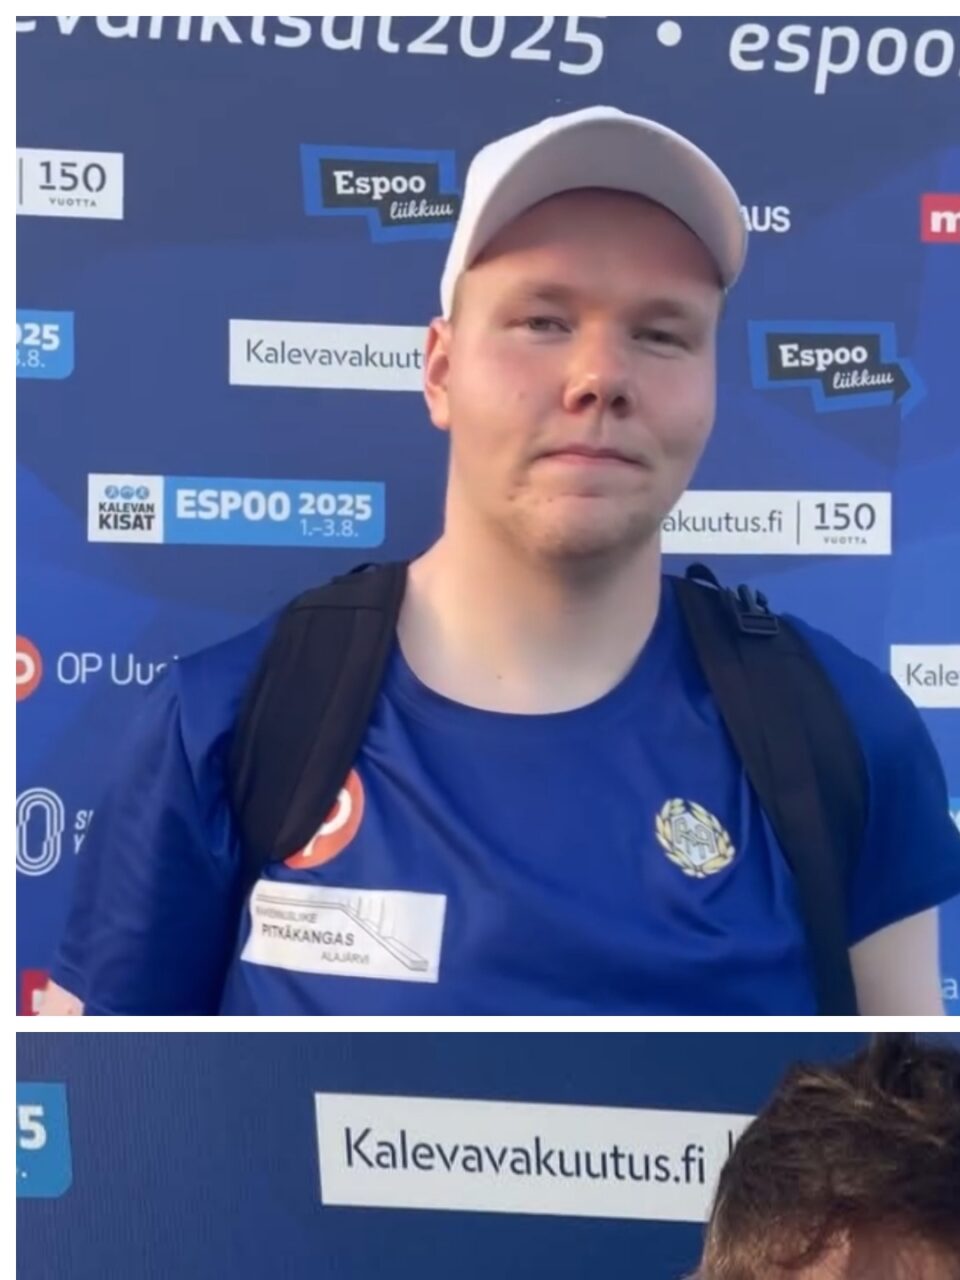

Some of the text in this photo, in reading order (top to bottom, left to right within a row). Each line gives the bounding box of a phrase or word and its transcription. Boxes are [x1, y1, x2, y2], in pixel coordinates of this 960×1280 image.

[39, 160, 107, 194] 150
[333, 170, 426, 200] Espoo
[49, 197, 98, 208] VUOTTA
[390, 200, 454, 220] liikkuu
[779, 343, 868, 371] Espoo
[832, 370, 894, 390] liikkuu
[98, 502, 155, 516] KALEVAN
[176, 488, 372, 521] ESPOO 2025
[814, 502, 876, 531] 150
[98, 514, 155, 532] KISAT
[57, 652, 103, 684] OP
[262, 923, 355, 947] PITKÄKANGAS
[344, 1127, 708, 1186] Kalevavakuutus.fi
